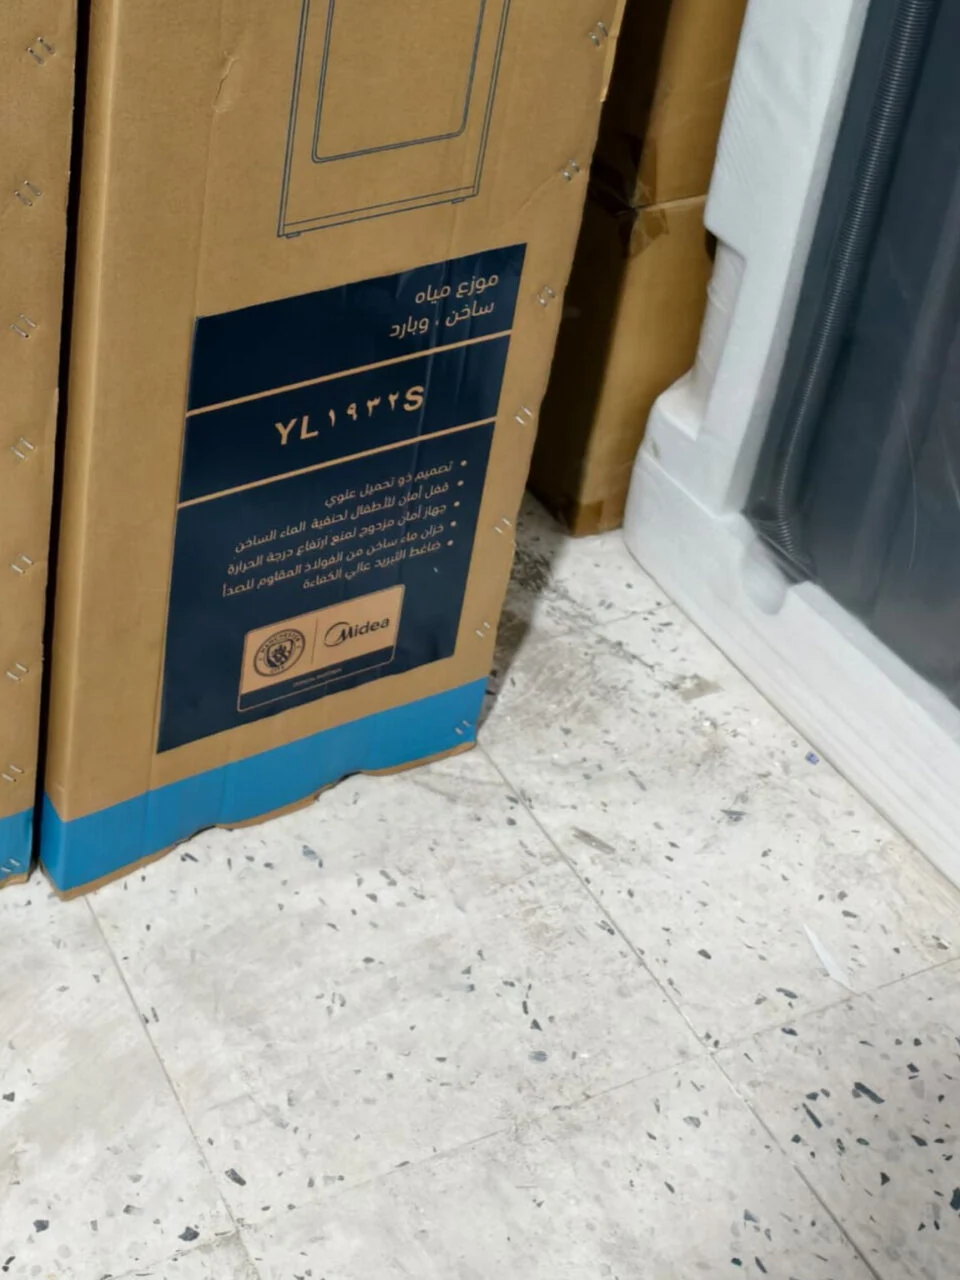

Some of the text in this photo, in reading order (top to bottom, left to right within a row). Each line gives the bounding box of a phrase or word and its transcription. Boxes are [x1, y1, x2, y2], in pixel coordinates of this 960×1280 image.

[414, 273, 499, 304] موزع مياه
[389, 315, 430, 340] وبارد
[323, 617, 390, 648] Midea
